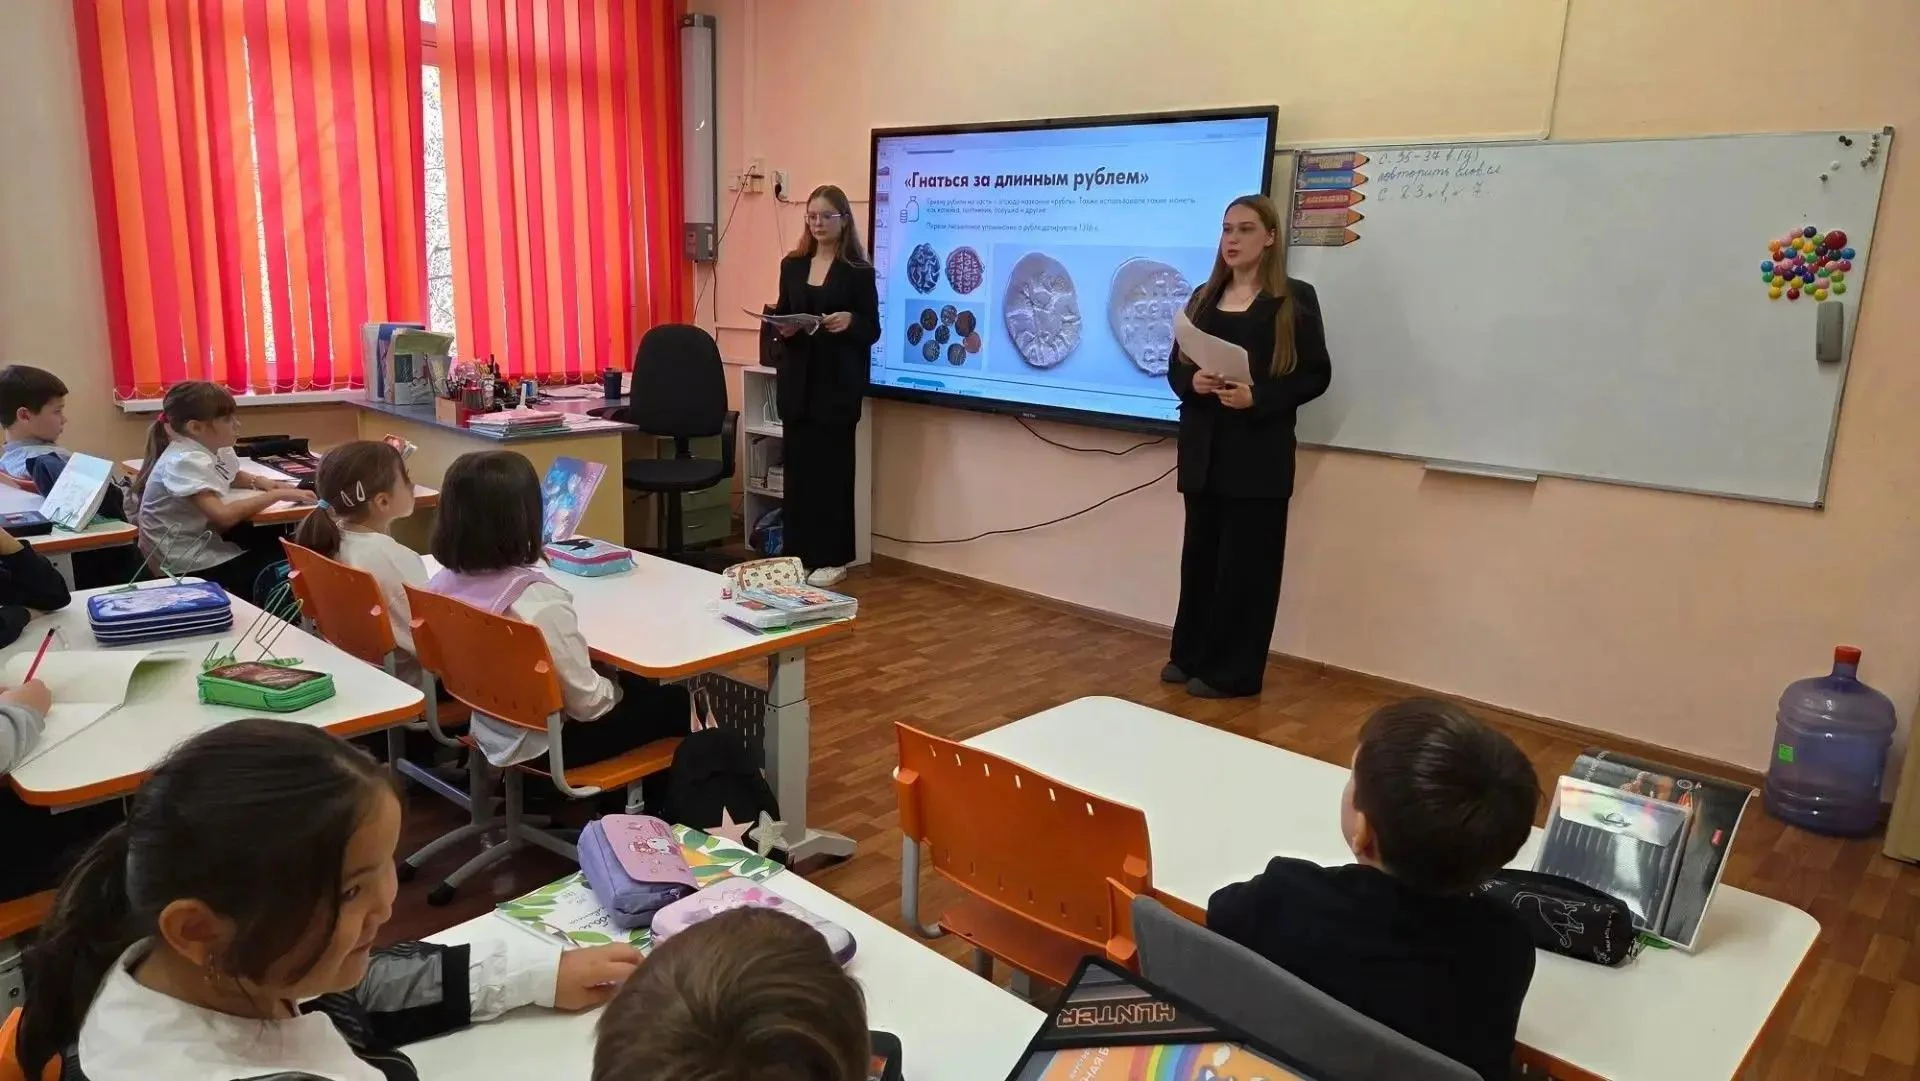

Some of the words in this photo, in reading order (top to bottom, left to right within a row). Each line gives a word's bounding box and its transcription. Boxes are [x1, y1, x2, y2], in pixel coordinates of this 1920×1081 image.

[904, 171, 969, 190] «Гнаться
[973, 174, 991, 188] за
[994, 173, 1069, 189] длинным
[1073, 166, 1150, 191] рублем»
[1056, 1002, 1176, 1028] HUNTER
